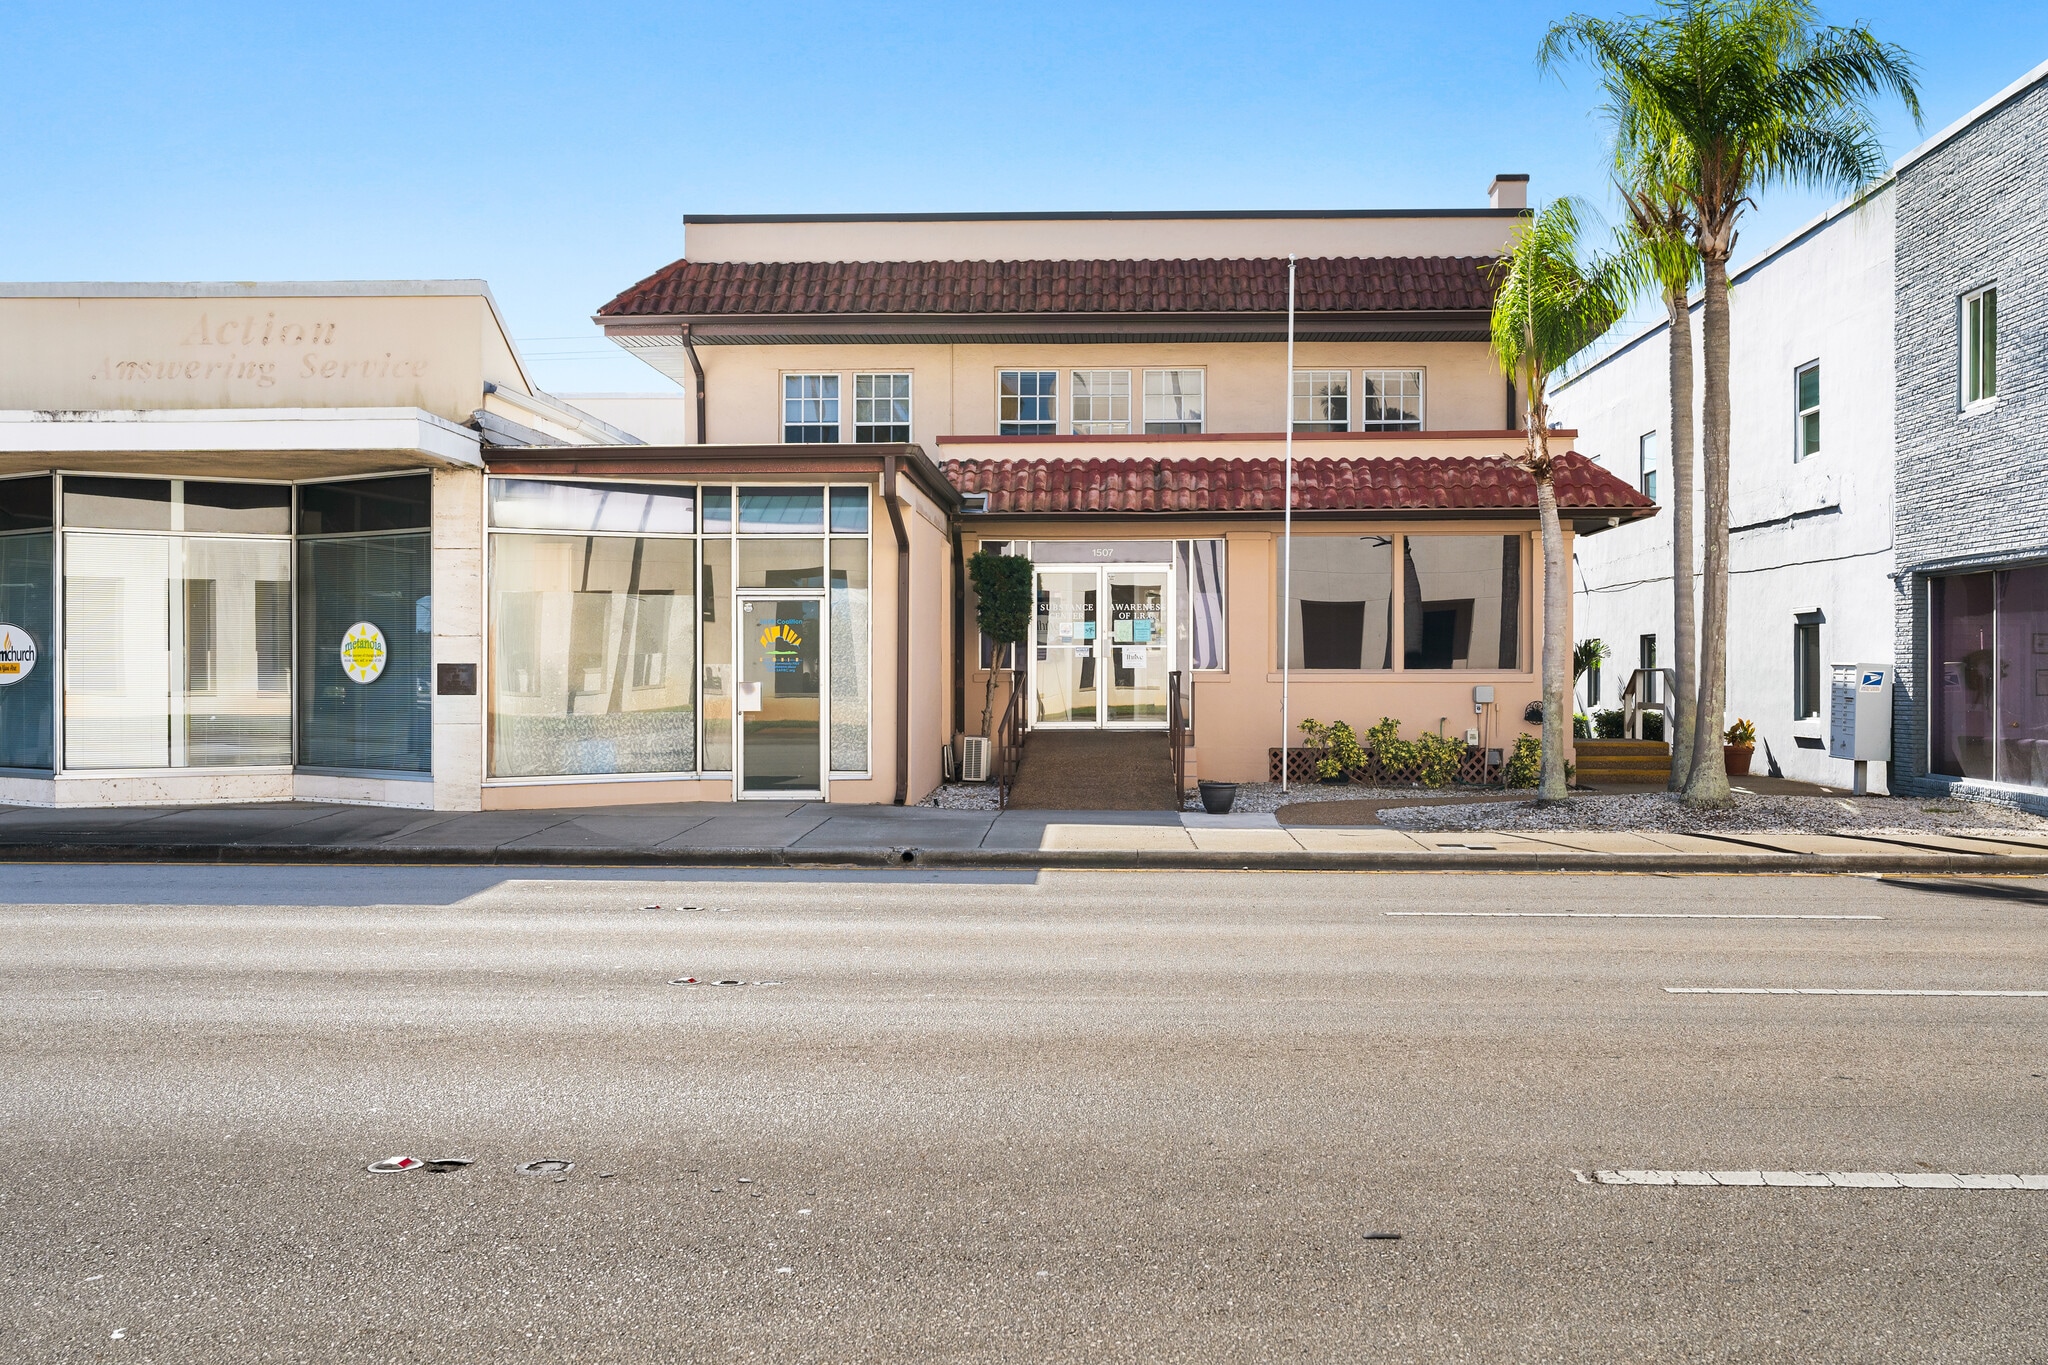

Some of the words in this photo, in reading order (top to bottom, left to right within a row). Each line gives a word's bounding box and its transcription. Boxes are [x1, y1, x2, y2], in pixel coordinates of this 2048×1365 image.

[180, 312, 336, 346] Action
[97, 353, 276, 387] Answering
[300, 352, 429, 379] Service
[1092, 548, 1114, 557] 1507
[1040, 603, 1094, 611] SUBSTANCE
[1118, 612, 1131, 620] OF
[344, 638, 382, 653] metanoia
